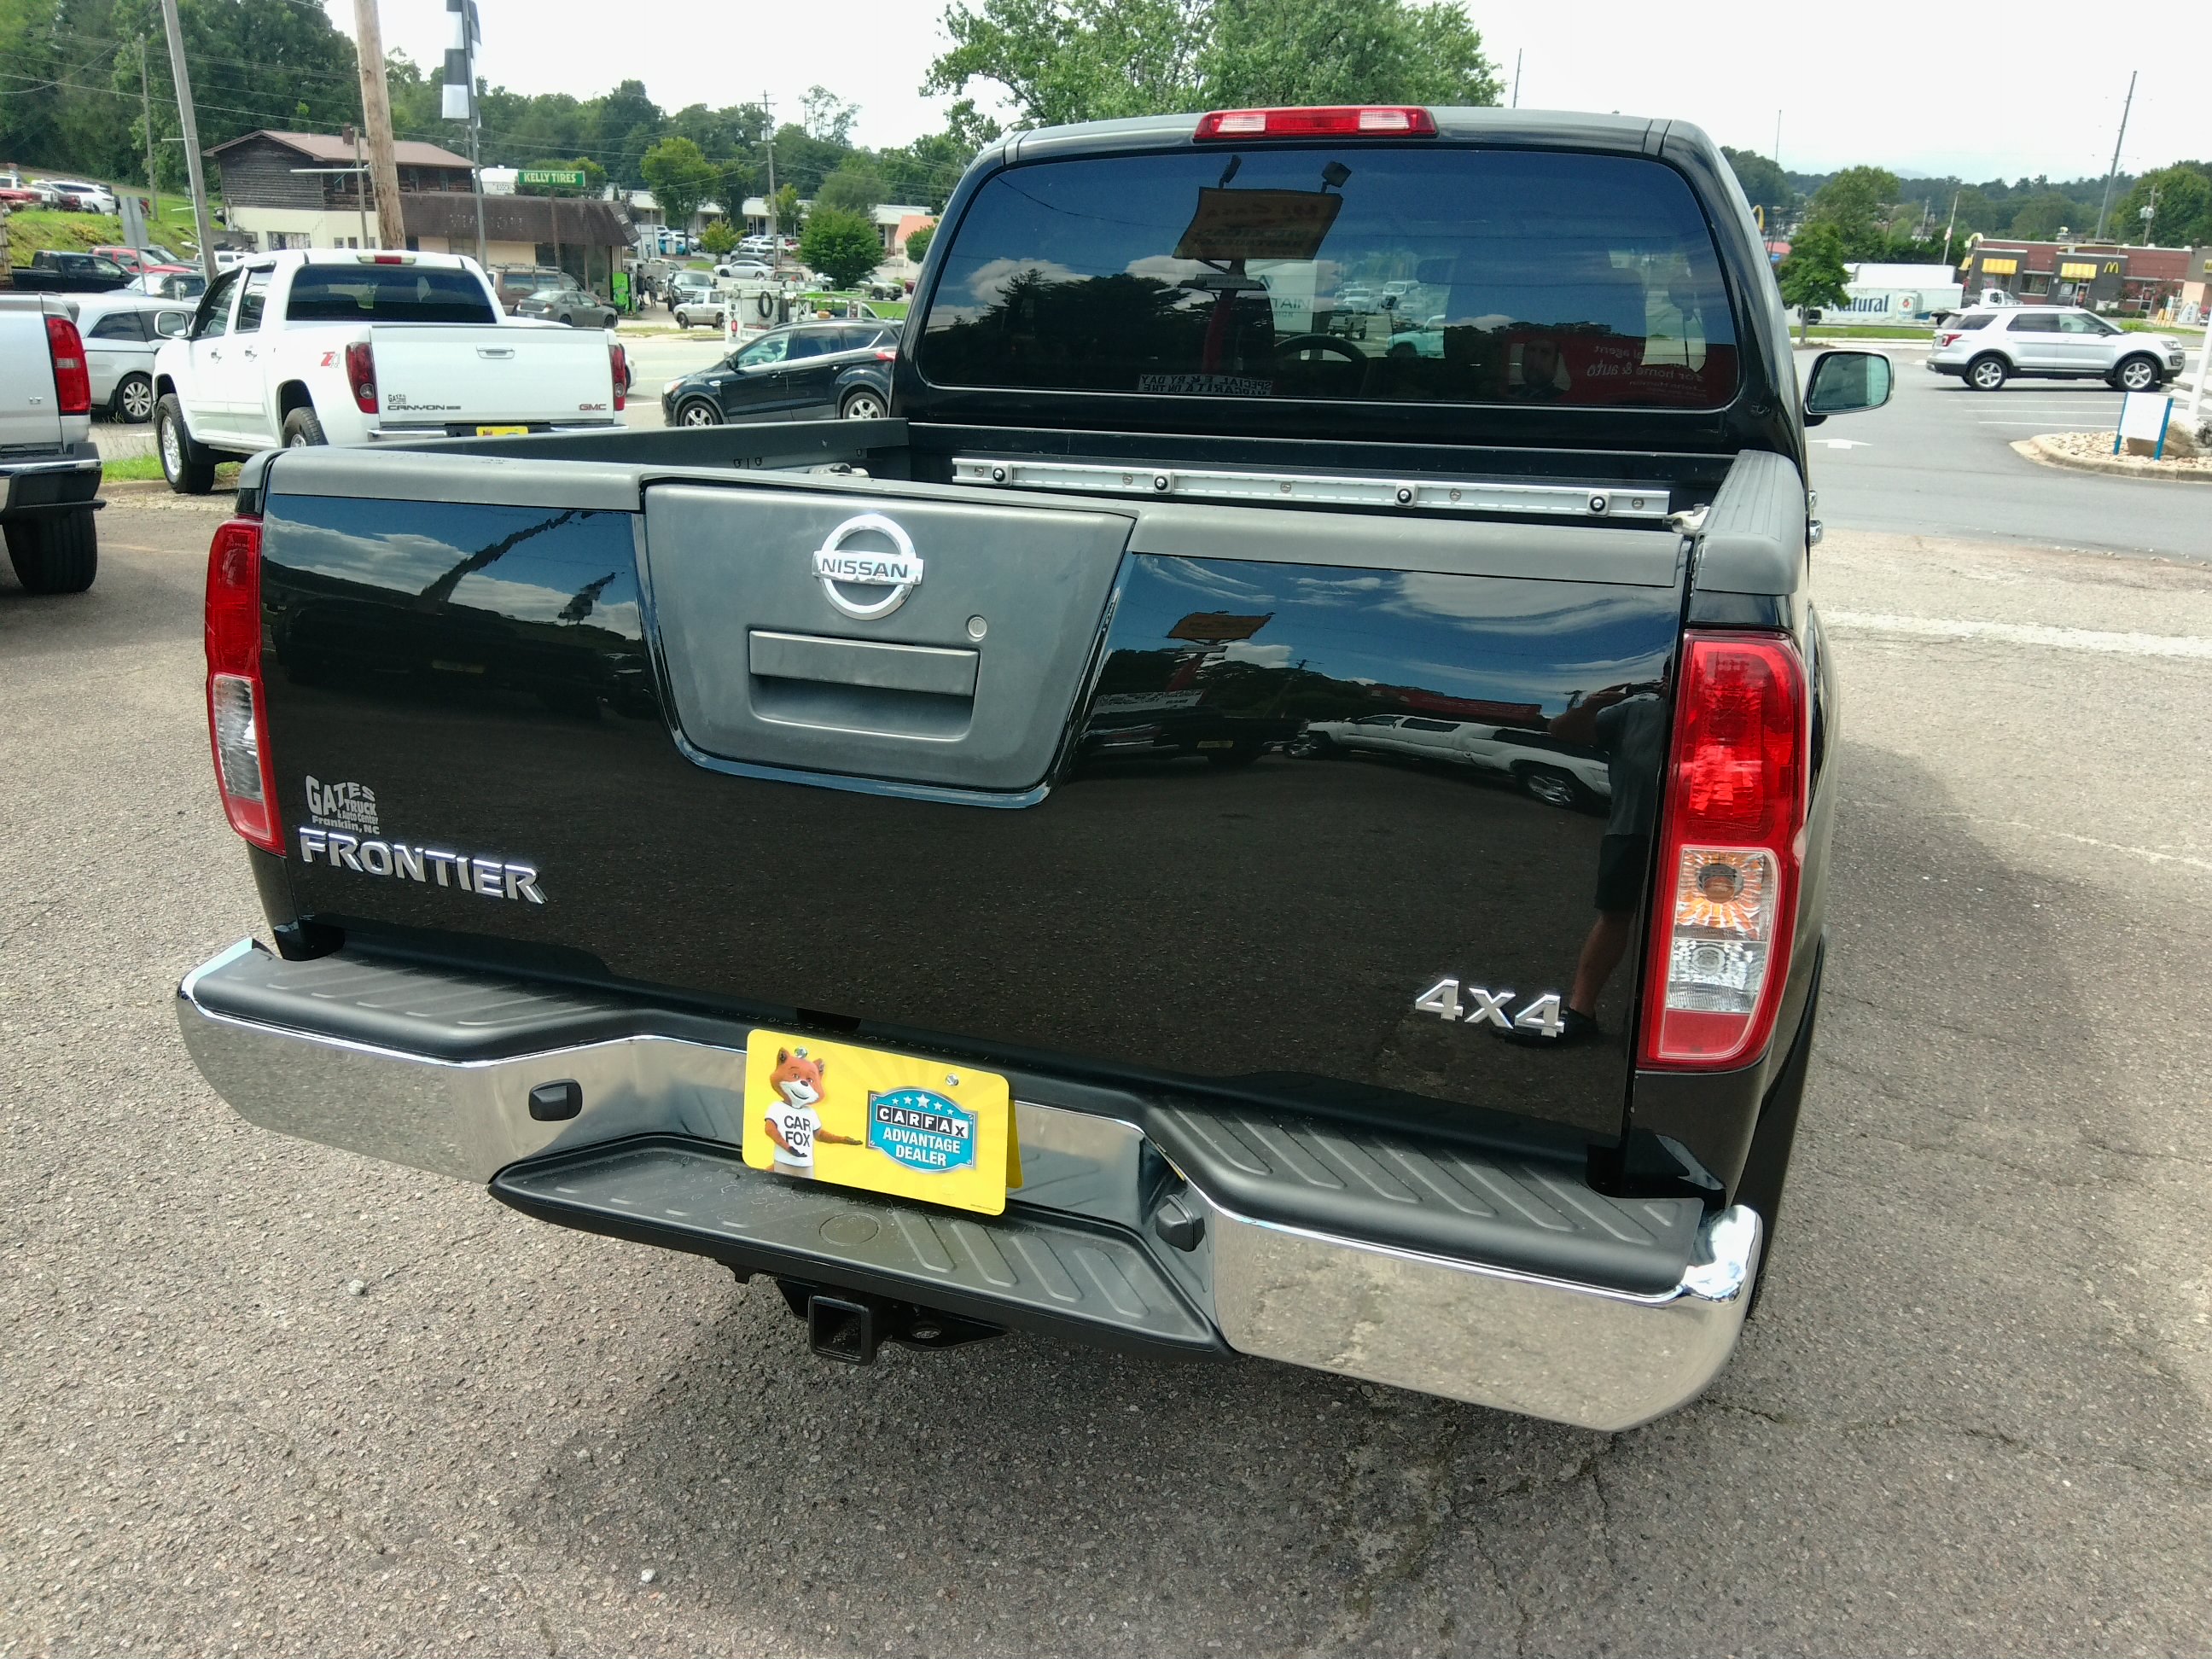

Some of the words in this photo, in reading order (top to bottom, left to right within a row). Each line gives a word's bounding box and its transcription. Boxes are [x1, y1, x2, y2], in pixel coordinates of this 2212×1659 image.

[524, 172, 550, 183] KELLY
[551, 172, 577, 183] TIRES
[1271, 298, 1312, 309] TAIN
[822, 557, 909, 579] NISSAN
[306, 775, 376, 816] GATES
[344, 799, 377, 816] TRUCK
[358, 813, 379, 825] Center
[364, 824, 381, 835] NC
[300, 826, 549, 905] FRONTIER
[784, 1115, 811, 1132] CAR
[877, 1104, 969, 1139] CARFAX
[785, 1131, 812, 1148] FOX
[882, 1126, 961, 1155] ADVANTAGE
[895, 1144, 947, 1167] DEALER
